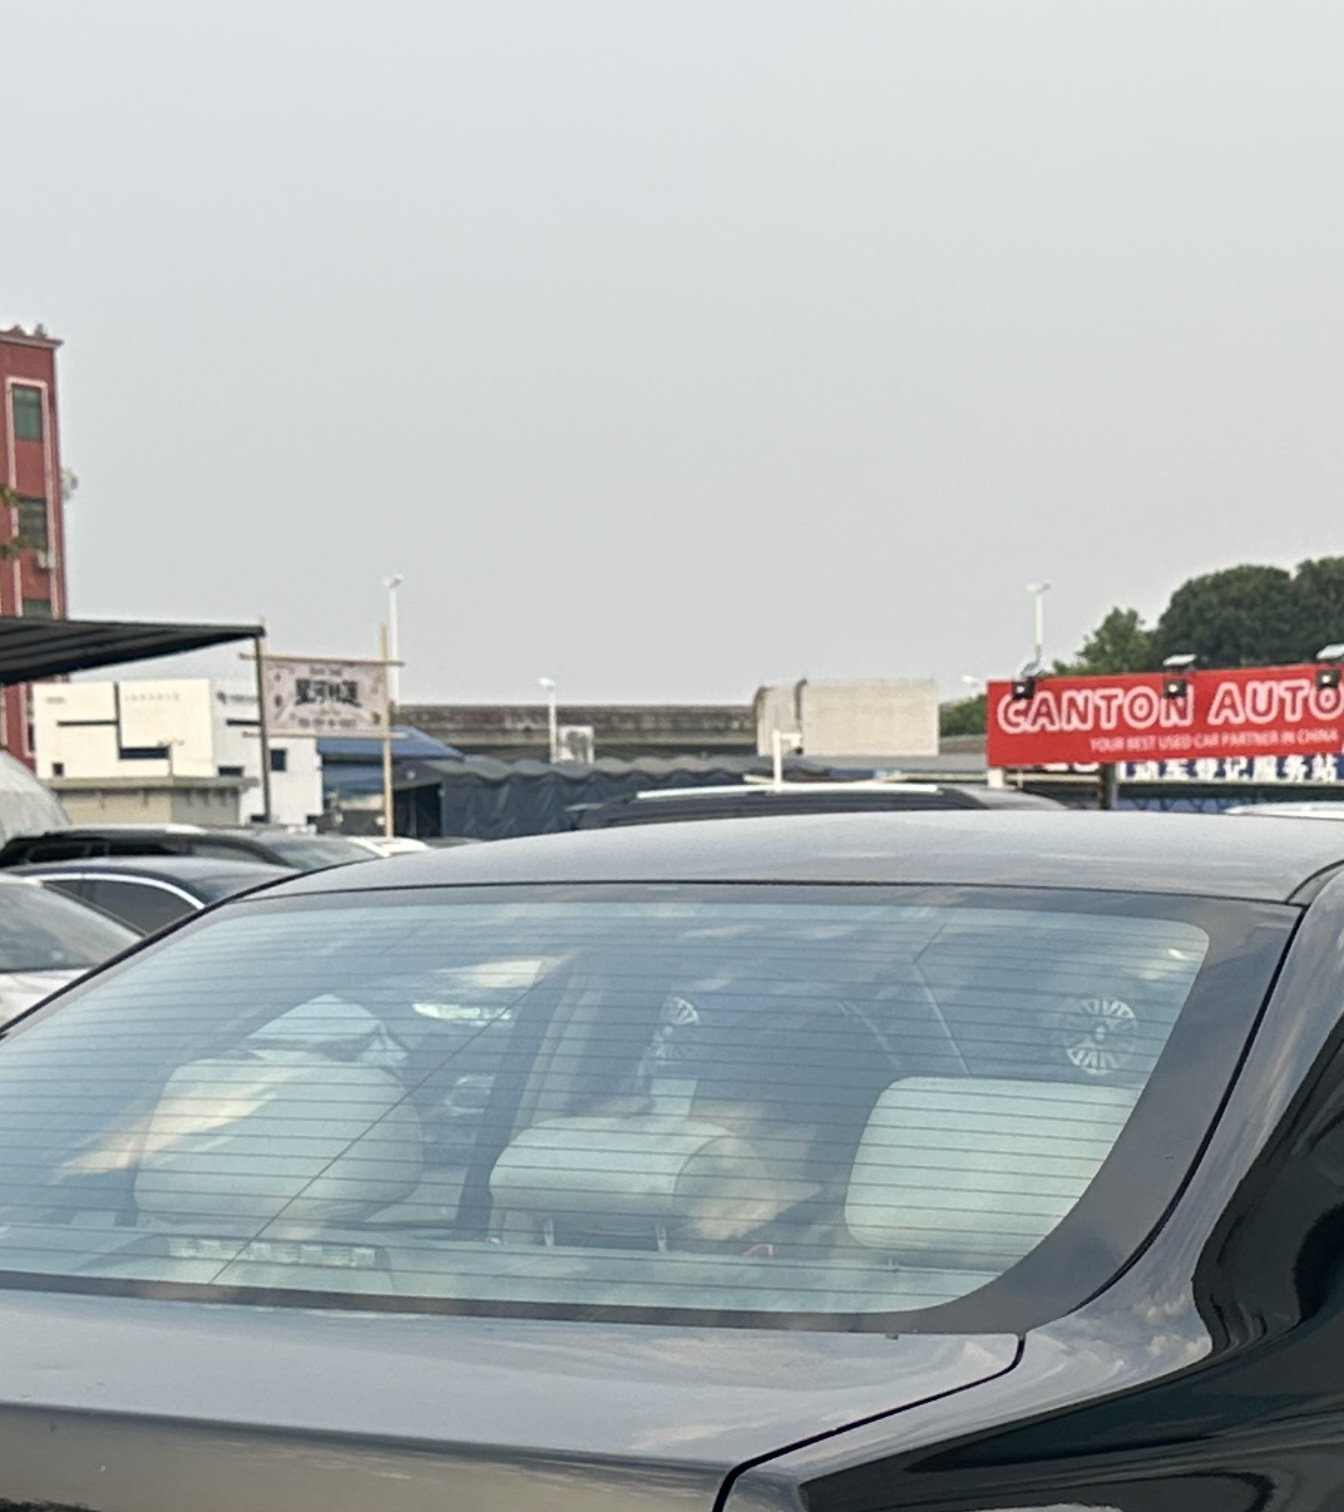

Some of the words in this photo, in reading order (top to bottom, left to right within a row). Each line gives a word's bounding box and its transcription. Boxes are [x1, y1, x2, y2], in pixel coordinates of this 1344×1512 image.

[997, 684, 1194, 734] CANTON
[1090, 737, 1124, 753] YOUR
[1126, 735, 1156, 751] BEST
[1158, 733, 1191, 750] USED
[1194, 732, 1219, 748] CAR
[1221, 729, 1278, 747] PARTNER
[1280, 729, 1295, 744] IN
[1297, 727, 1339, 745] CHINA
